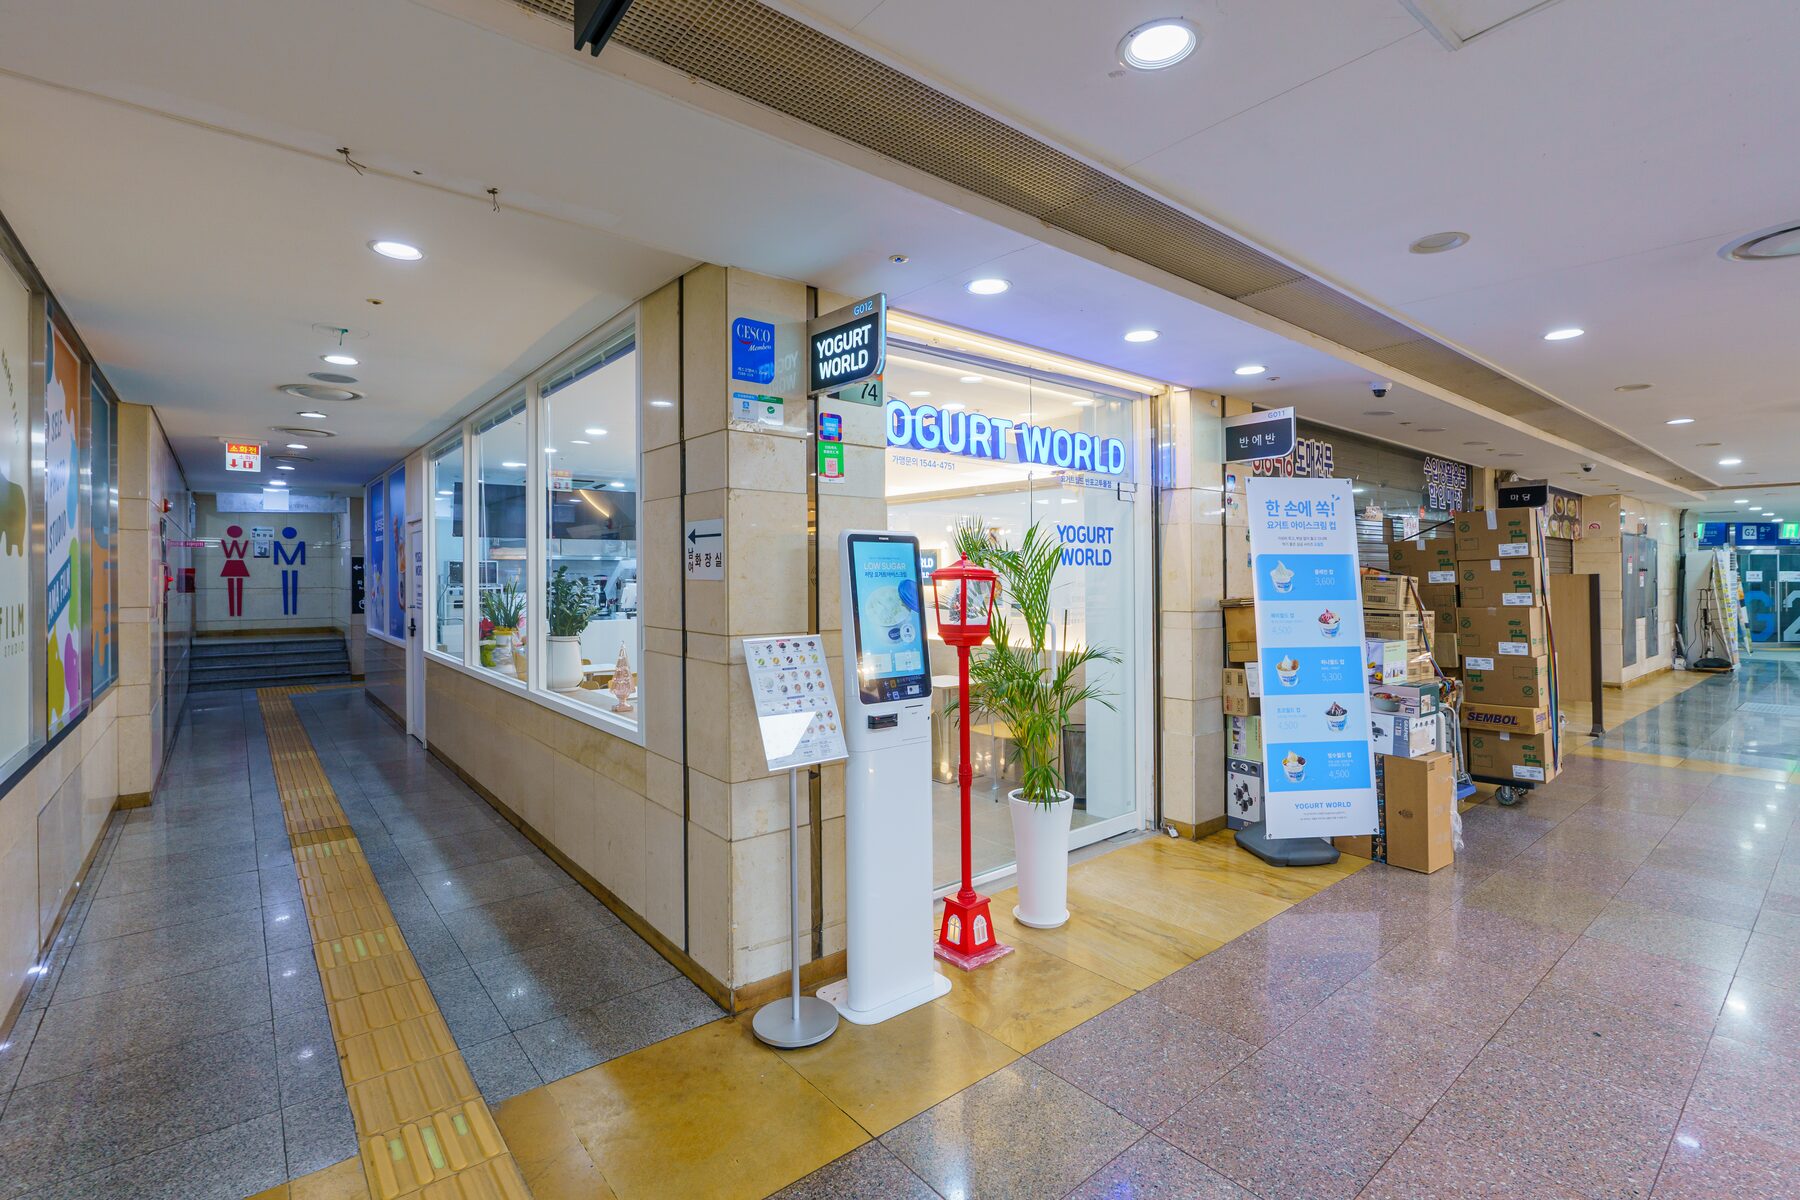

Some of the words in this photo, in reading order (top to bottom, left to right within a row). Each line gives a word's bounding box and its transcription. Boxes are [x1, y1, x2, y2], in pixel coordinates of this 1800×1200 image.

[854, 301, 873, 316] G012
[736, 323, 771, 343] CESCO
[816, 324, 872, 359] YOGURT
[819, 349, 869, 380] WORLD
[860, 383, 878, 401] 74
[1268, 410, 1286, 419] G011
[51, 410, 63, 442] SELF
[887, 400, 1013, 459] OGURT
[1015, 421, 1126, 475] WORLD
[229, 445, 257, 455] 소화전
[892, 455, 919, 467] 가맹문의
[919, 459, 956, 471] 1544-4751
[1265, 499, 1280, 517] 한
[1284, 499, 1312, 517] 손에
[1316, 499, 1336, 517] 쏙!
[1267, 520, 1289, 529] 요거트
[1291, 521, 1327, 531] 아이스크림
[1329, 521, 1337, 531] 컵
[1744, 528, 1756, 537] G2
[1057, 524, 1114, 545] YOGURT
[695, 552, 722, 568] 화장실
[1060, 547, 1112, 567] WORLD
[863, 561, 881, 570] LOW
[882, 562, 906, 571] SUGAR
[1314, 576, 1336, 587] 3,600
[1321, 672, 1343, 682] 5,300
[1467, 711, 1518, 726] SEMBOL
[1328, 769, 1350, 779] 4,500
[1295, 802, 1324, 810] YOGURT
[1326, 801, 1352, 809] WORLD
